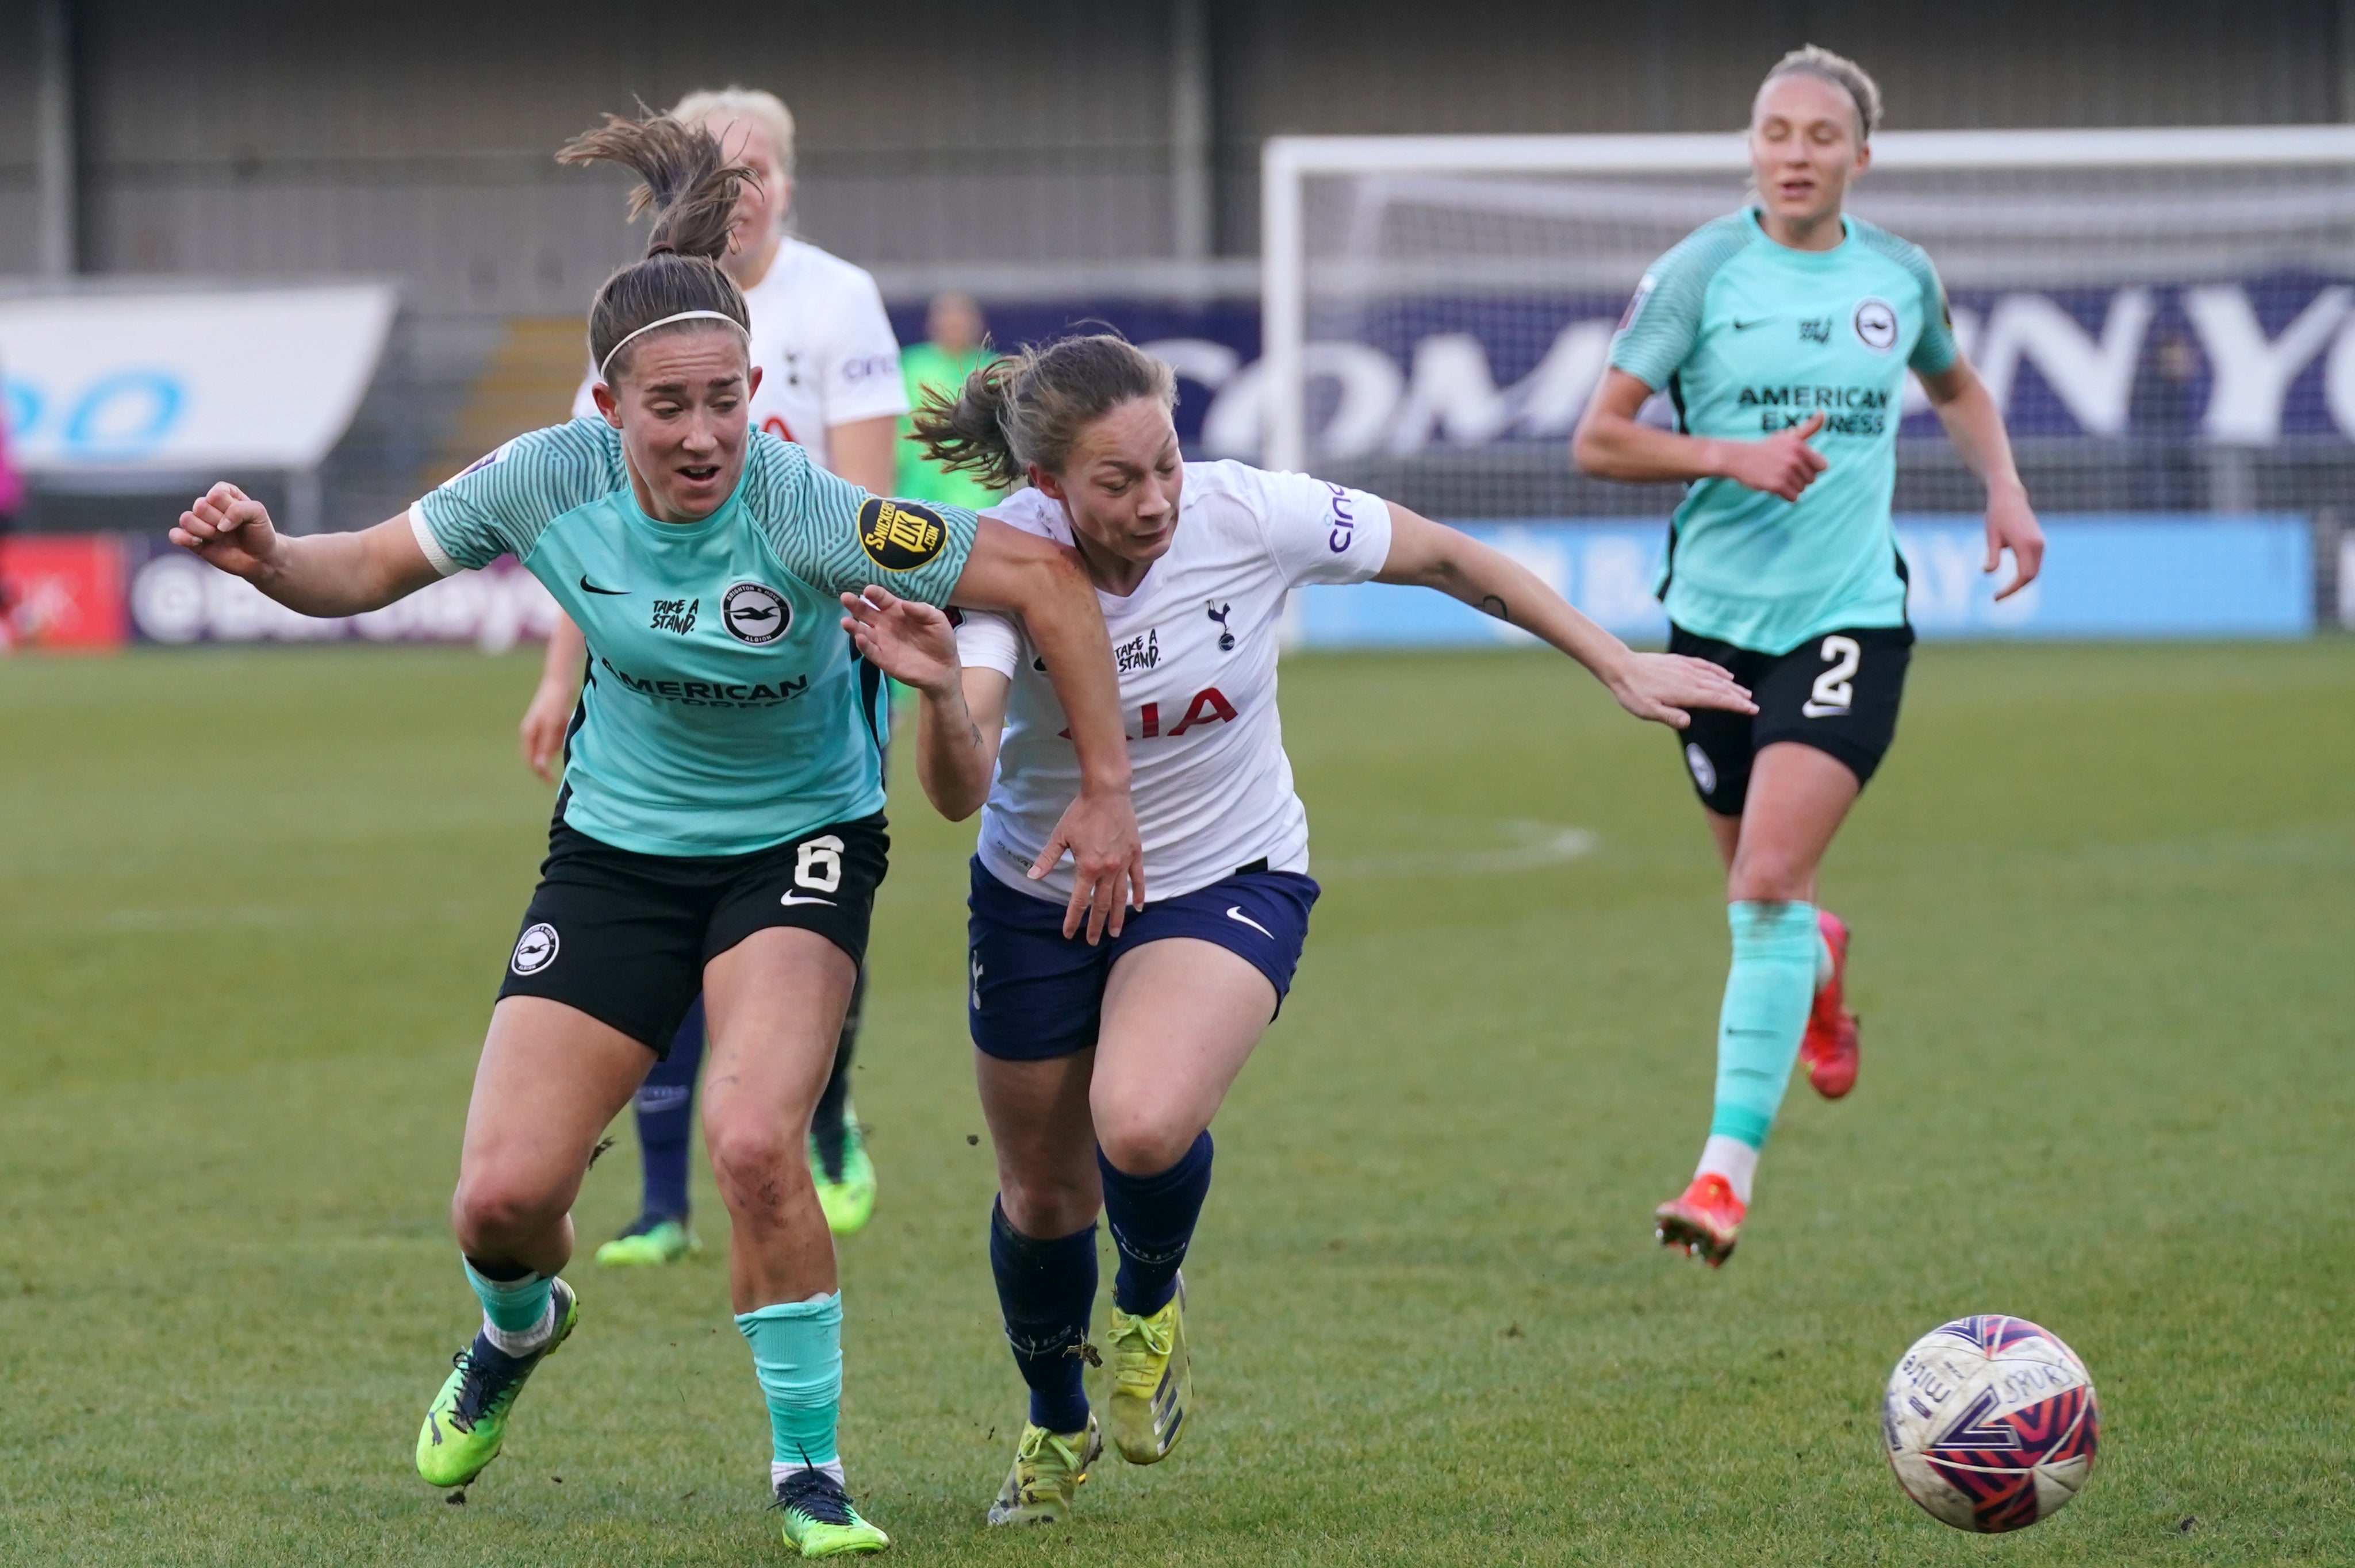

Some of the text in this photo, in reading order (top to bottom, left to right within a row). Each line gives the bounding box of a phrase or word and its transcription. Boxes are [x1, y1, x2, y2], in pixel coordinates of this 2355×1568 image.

[1739, 385, 1890, 408] AMERICAN
[1762, 410, 1885, 435] EXRESS
[891, 511, 925, 550] UK
[654, 598, 699, 614] TAKE A
[650, 613, 696, 636] STAND.
[1114, 628, 1158, 659] TAKE A
[1119, 645, 1161, 672] STAND.
[1820, 635, 1861, 707] 2
[602, 657, 807, 700] AMERICAN
[795, 835, 845, 893] 6
